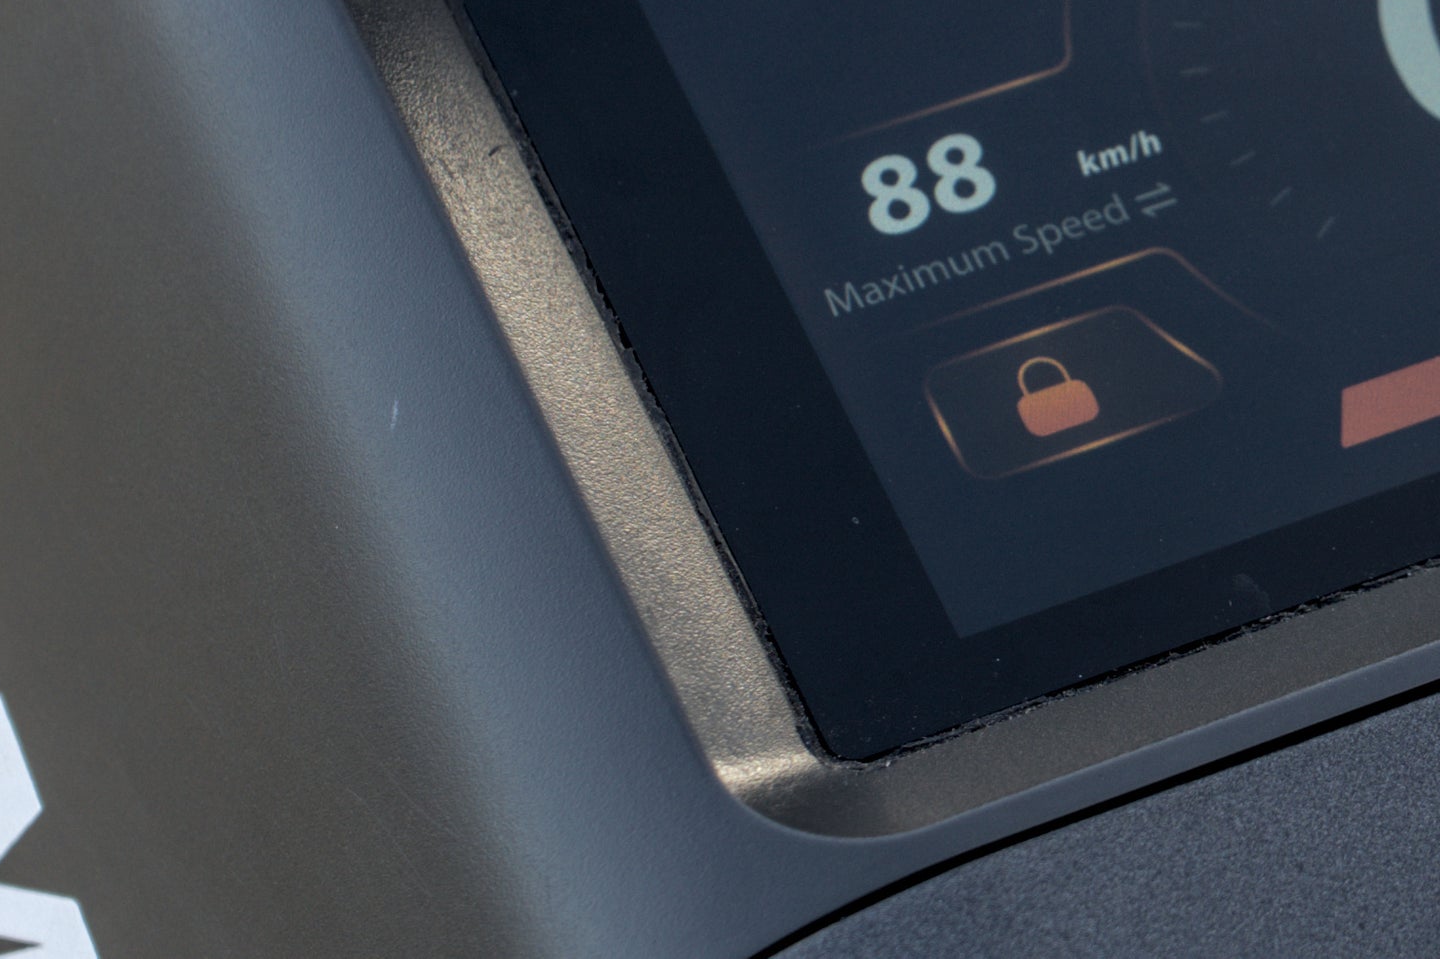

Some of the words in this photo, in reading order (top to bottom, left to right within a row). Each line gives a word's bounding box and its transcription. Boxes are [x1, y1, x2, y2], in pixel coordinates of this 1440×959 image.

[860, 132, 998, 236] 88
[1076, 129, 1163, 178] km/h
[822, 239, 1011, 319] Maximum
[1011, 191, 1131, 256] Speed
